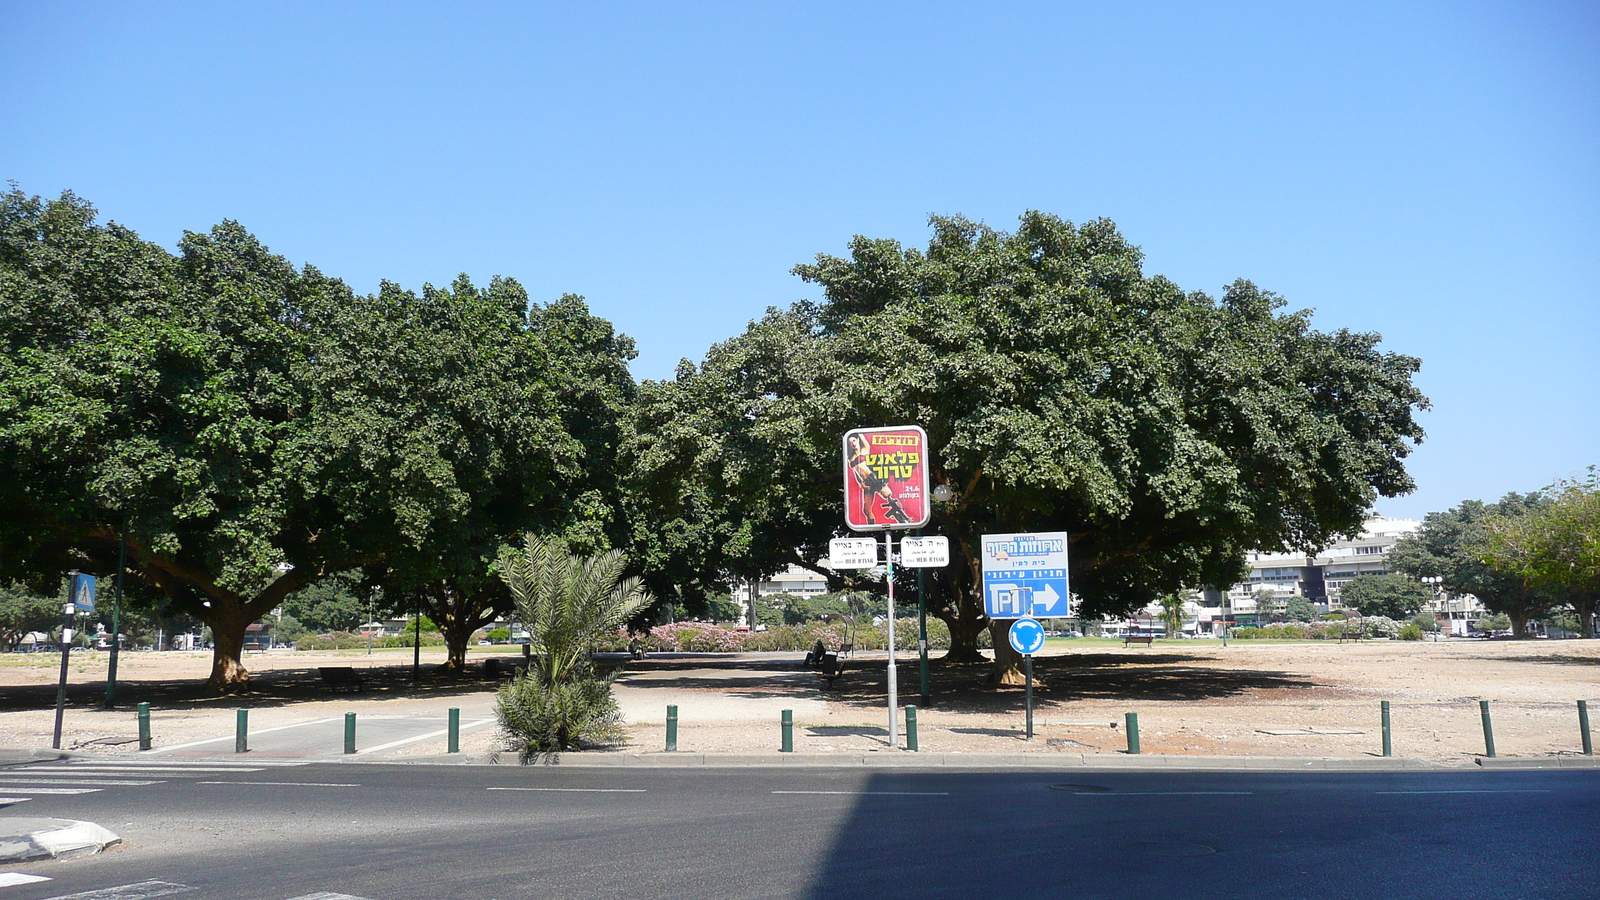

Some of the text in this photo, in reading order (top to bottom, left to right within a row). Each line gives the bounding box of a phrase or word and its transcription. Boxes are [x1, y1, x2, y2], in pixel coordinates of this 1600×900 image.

[866, 451, 919, 466] פלאנט
[873, 465, 913, 479] טרור
[987, 570, 1063, 579] חניון עירוני
